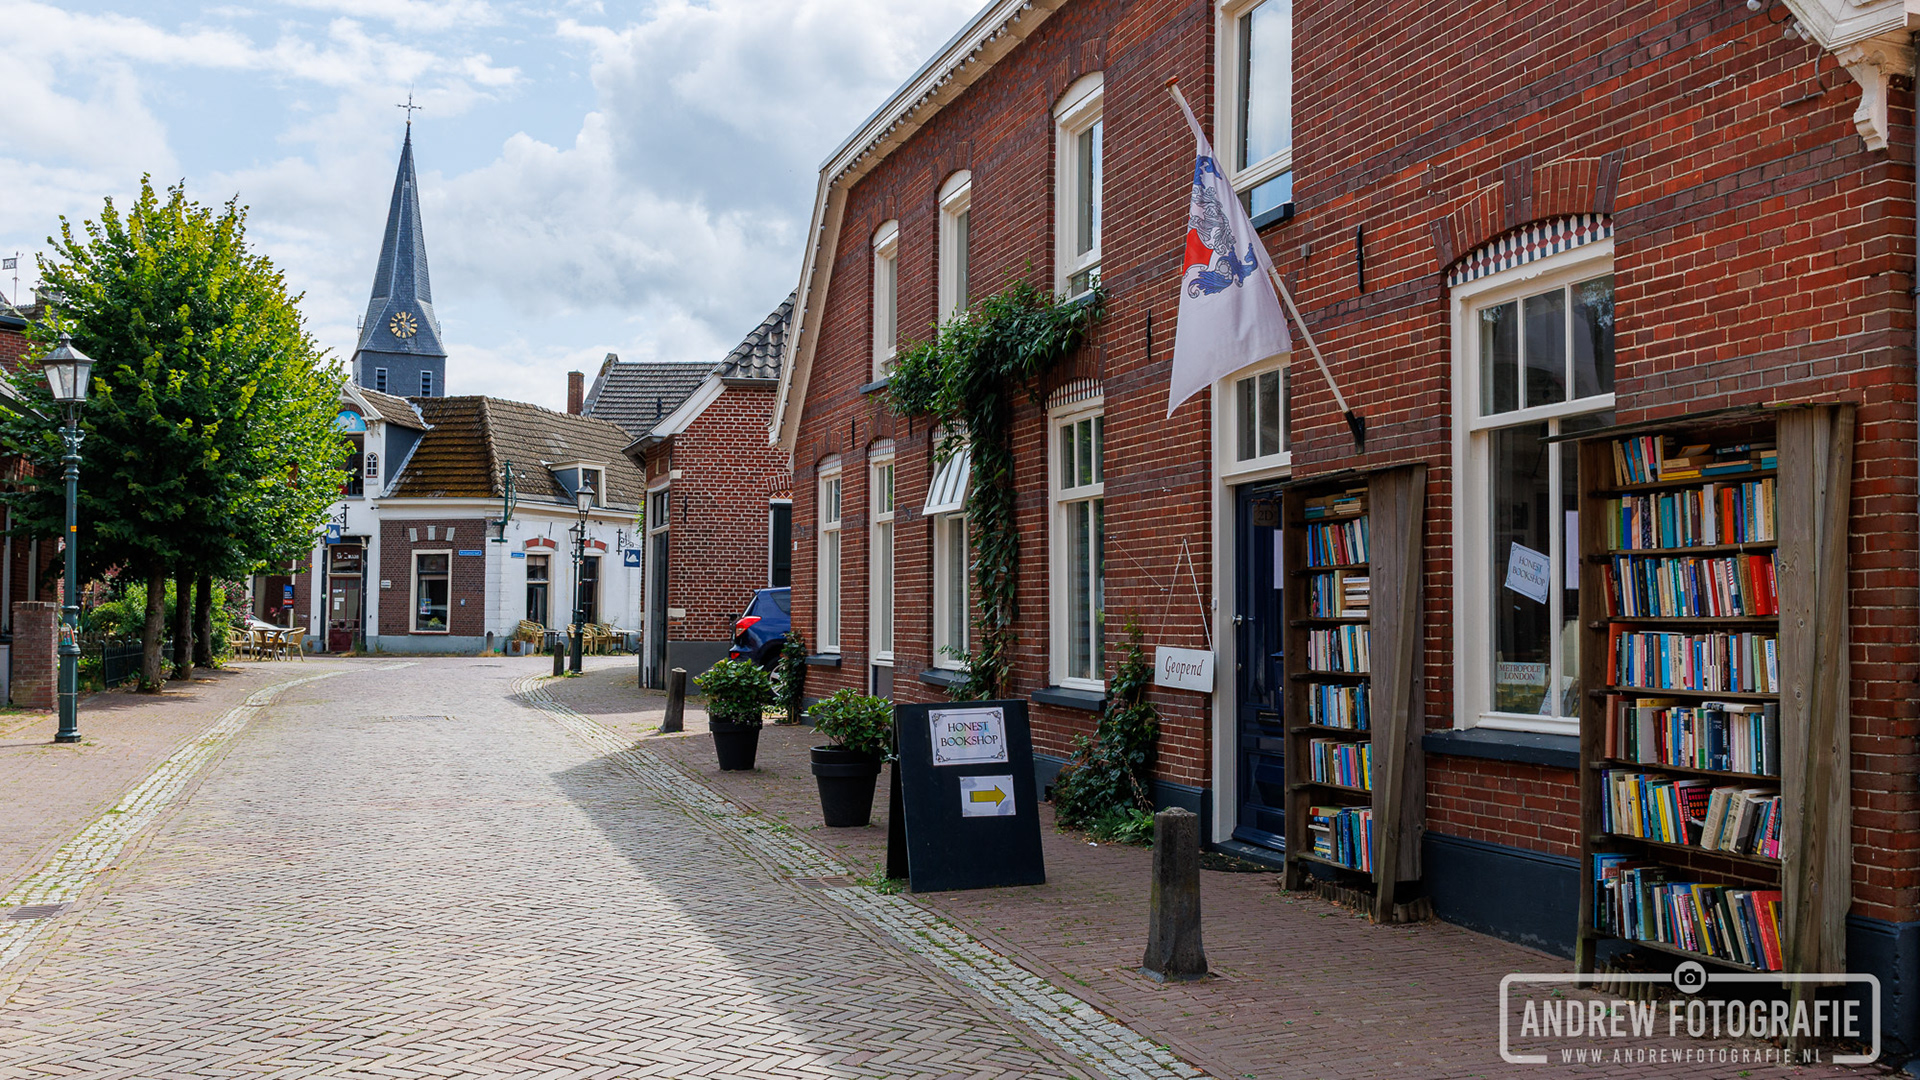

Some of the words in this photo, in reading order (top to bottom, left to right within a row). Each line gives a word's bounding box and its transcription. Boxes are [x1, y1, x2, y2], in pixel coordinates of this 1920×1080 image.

[1519, 556, 1543, 573] HONEST
[1512, 567, 1546, 587] BOOKSHOP
[1165, 656, 1204, 680] Geopend
[1499, 664, 1541, 673] METROPOLE
[1504, 672, 1536, 681] LONDON
[948, 722, 988, 732] HONEST
[941, 735, 998, 746] BOOKSHOP
